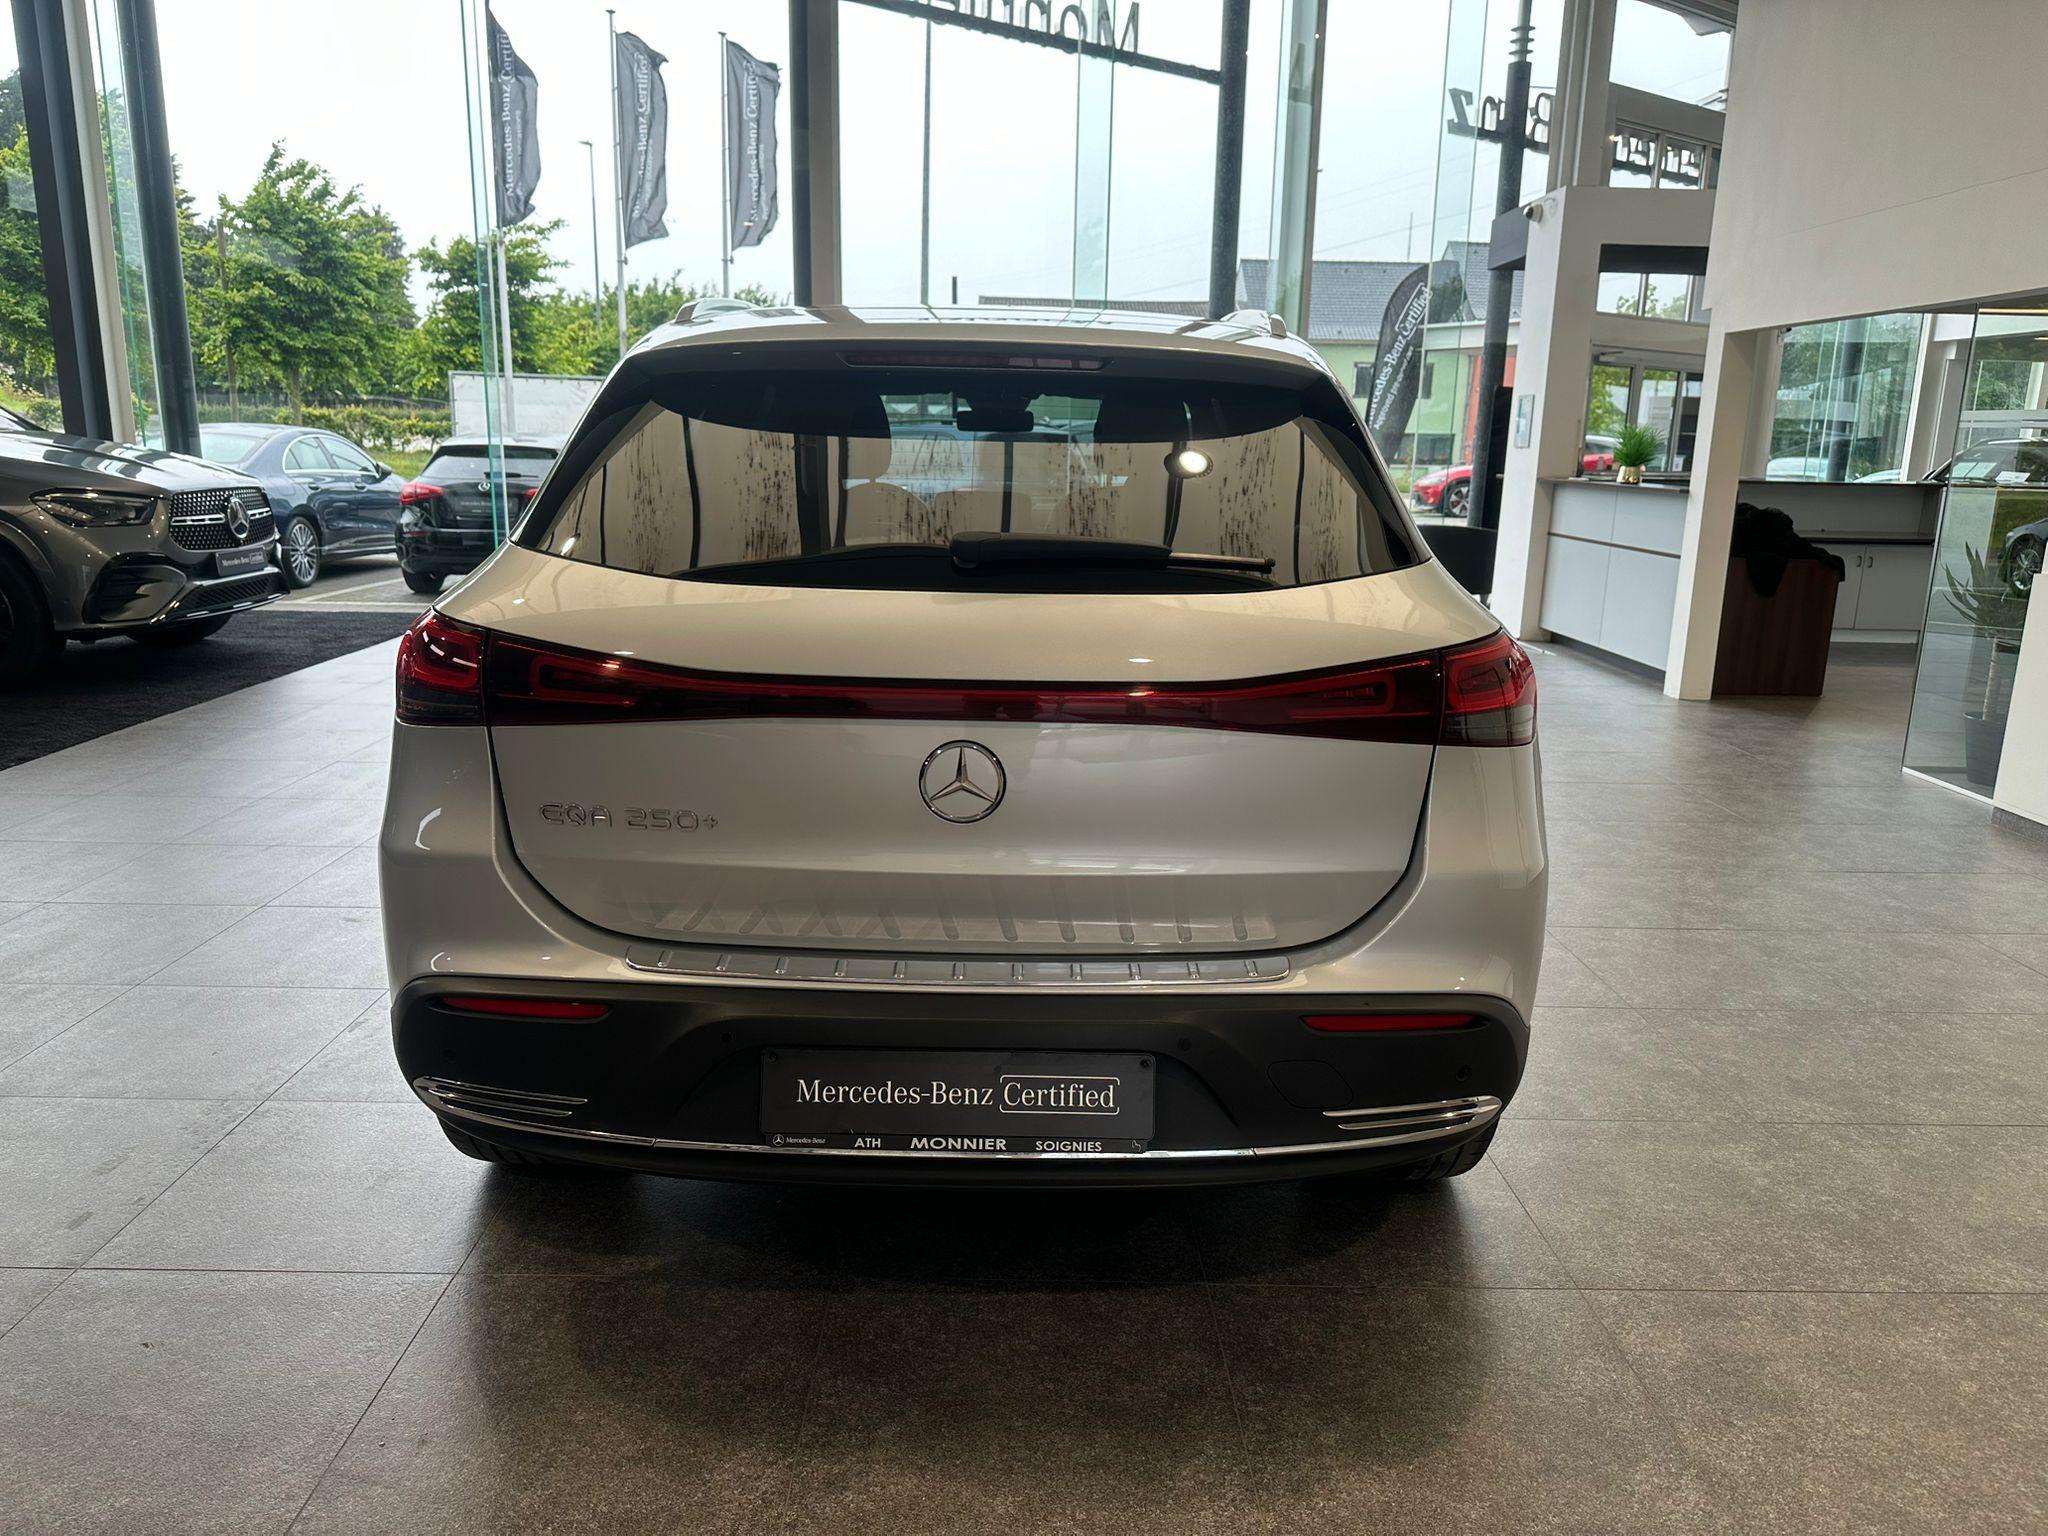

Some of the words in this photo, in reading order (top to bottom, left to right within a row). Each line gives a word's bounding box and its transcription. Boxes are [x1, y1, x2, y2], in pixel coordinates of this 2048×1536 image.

[1369, 335, 1407, 429] ercedes-Benz
[539, 803, 613, 827] EQA
[624, 806, 719, 832] 250+
[796, 1079, 994, 1105] Mercedes-Benz
[1004, 1082, 1115, 1108] Certified
[854, 1137, 882, 1149] ATH
[909, 1137, 1008, 1151] MONNIER
[1035, 1140, 1103, 1152] SOIGNIES
